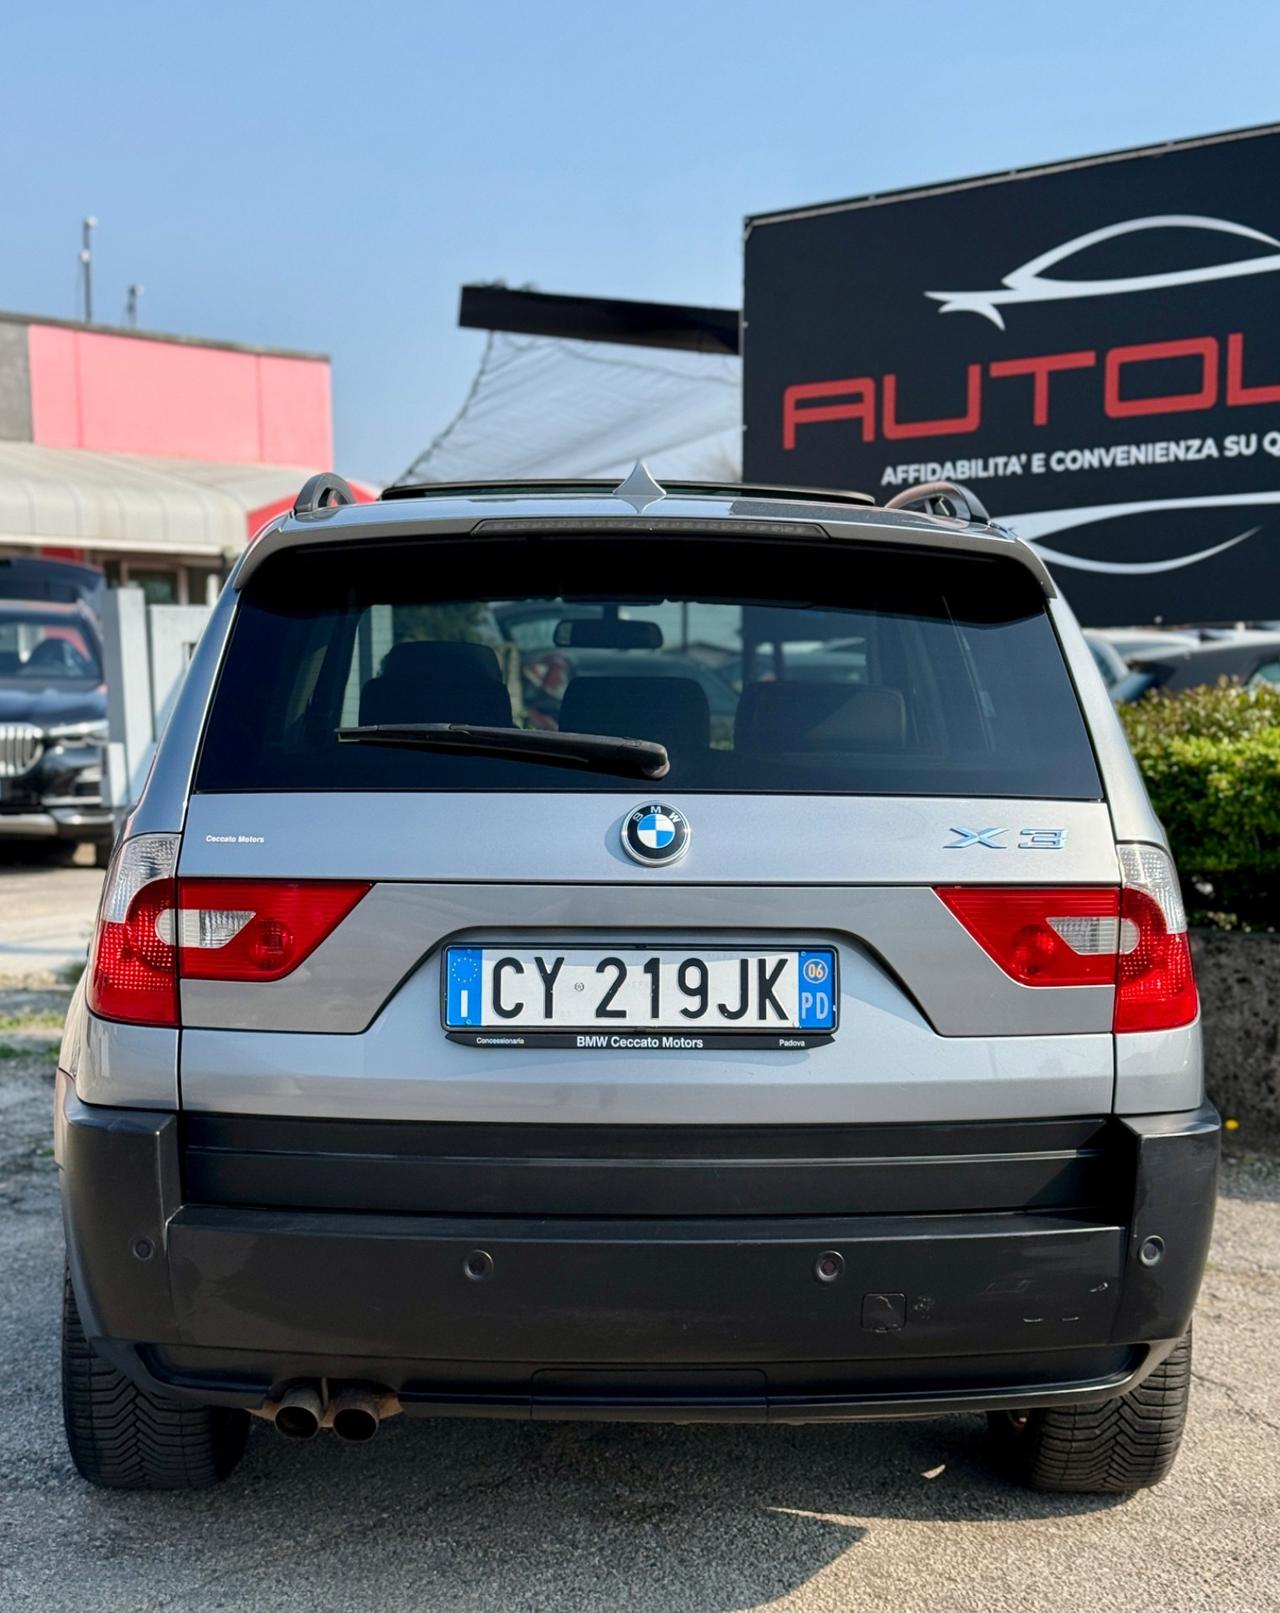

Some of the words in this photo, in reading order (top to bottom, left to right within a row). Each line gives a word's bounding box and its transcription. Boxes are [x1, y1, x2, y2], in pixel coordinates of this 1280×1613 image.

[880, 453, 1027, 486] AFFIDABILITA'
[1031, 452, 1046, 474] E
[1050, 437, 1220, 472] CONVENIENZA
[1223, 432, 1258, 457] SU
[632, 805, 681, 823] BMW
[206, 834, 236, 843] Ceccato
[238, 835, 265, 844] Motors
[942, 826, 1068, 849] X3
[807, 963, 824, 979] 06
[493, 956, 565, 1019] CY
[594, 957, 789, 1020] 219JK
[801, 991, 829, 1020] PD
[476, 1036, 525, 1045] Concessionaria
[576, 1035, 608, 1048] BMW
[610, 1036, 659, 1049] Ceccato
[662, 1037, 704, 1049] Motors
[779, 1039, 805, 1047] Padova
